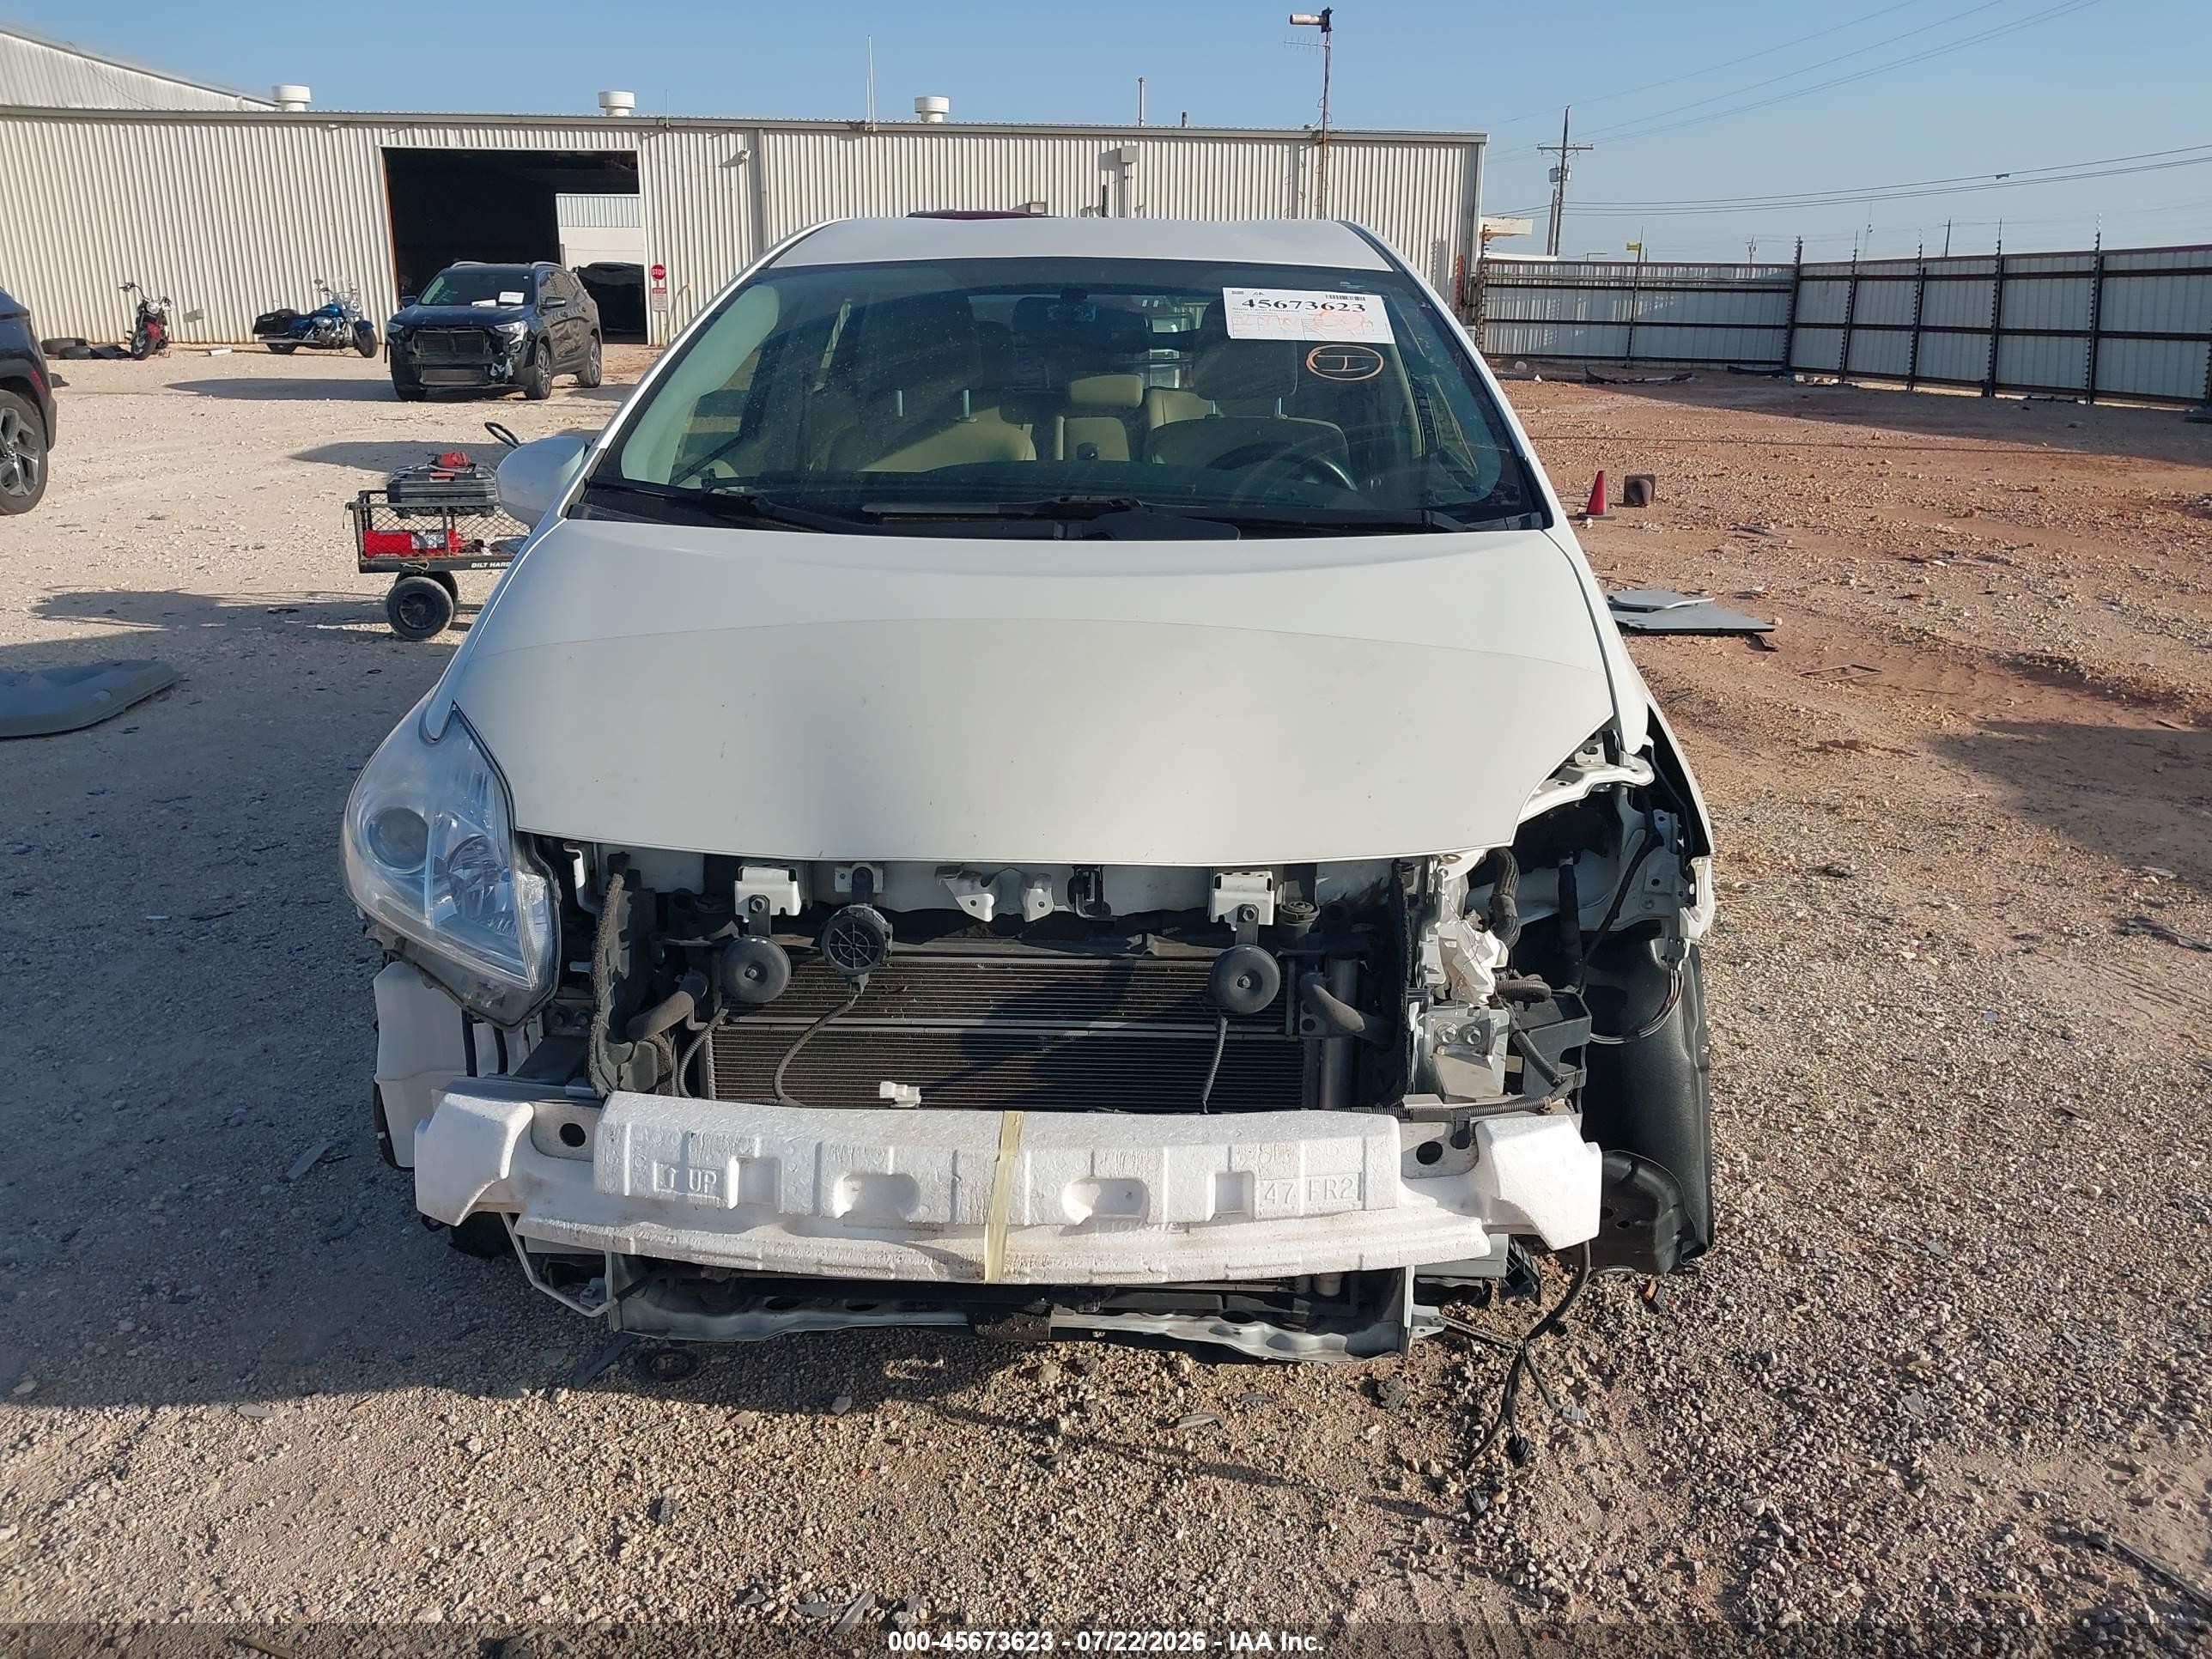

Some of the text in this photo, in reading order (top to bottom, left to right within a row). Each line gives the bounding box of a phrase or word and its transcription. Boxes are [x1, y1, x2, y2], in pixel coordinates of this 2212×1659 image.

[1242, 298, 1366, 313] 45673623
[689, 1168, 717, 1194] UP
[1264, 1176, 1354, 1205] 47 FR2
